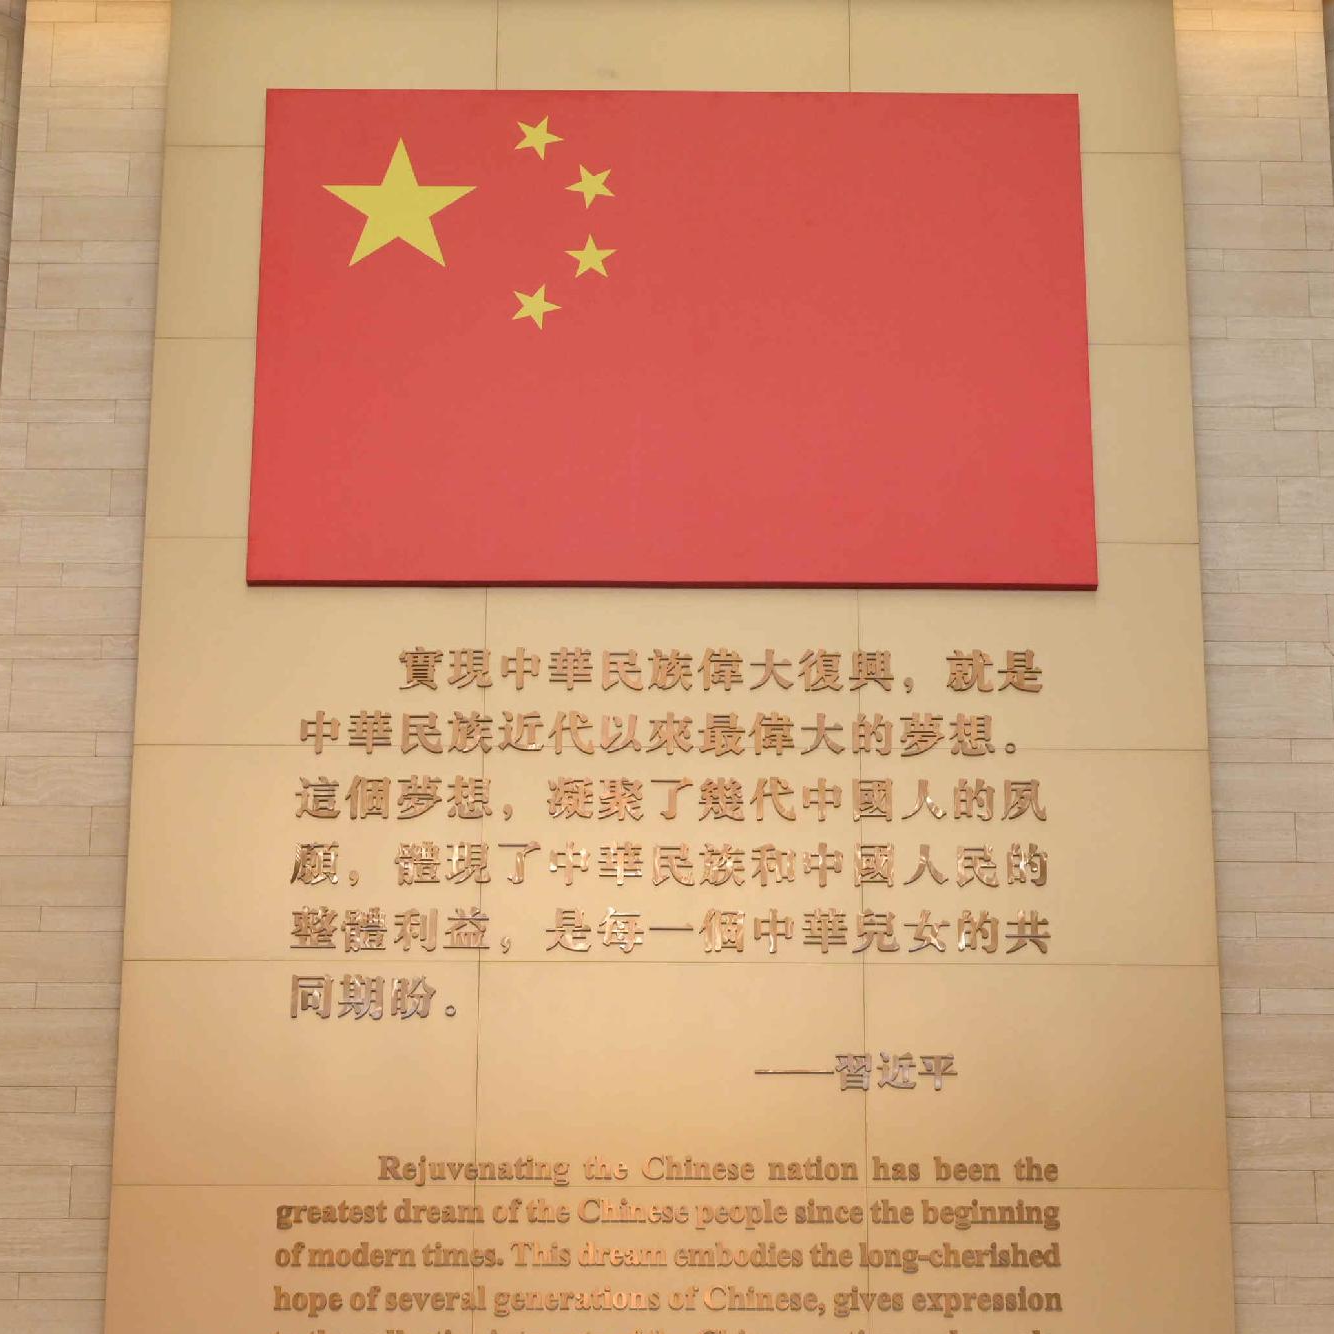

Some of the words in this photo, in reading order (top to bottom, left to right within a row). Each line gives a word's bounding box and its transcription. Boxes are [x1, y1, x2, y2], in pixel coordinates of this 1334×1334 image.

[299, 710, 1018, 757] 中華民族近代以來最偉大的夢想。
[290, 973, 457, 1021] 同期盼。
[378, 1156, 570, 1188] Rejuvenating
[583, 1156, 628, 1182] the
[642, 1156, 755, 1182] Chinese
[768, 1156, 858, 1182] nation
[873, 1156, 920, 1182] has
[933, 1156, 1000, 1182] been
[1014, 1156, 1058, 1182] the
[275, 1202, 386, 1230] greatest
[394, 1199, 485, 1224] dream
[492, 1199, 522, 1224] of
[526, 1199, 570, 1224] the
[577, 1199, 688, 1224] Chinese
[695, 1199, 787, 1230] people
[795, 1199, 864, 1224] since
[870, 1199, 914, 1224] the
[921, 1199, 1060, 1230] beginning
[275, 1241, 304, 1267] of
[308, 1241, 416, 1267] modern
[422, 1241, 504, 1267] times.
[510, 1241, 571, 1267] This
[578, 1241, 666, 1267] dream
[674, 1241, 803, 1267] embodies
[810, 1241, 853, 1267] the
[859, 1241, 1061, 1273] long-cherished
[272, 1284, 343, 1317] hope
[350, 1284, 381, 1311] of
[385, 1284, 486, 1311] several
[494, 1284, 660, 1317] generations
[667, 1284, 699, 1311] of
[704, 1284, 826, 1317] Chinese,
[834, 1284, 904, 1317] gives
[912, 1284, 1063, 1317] expression
